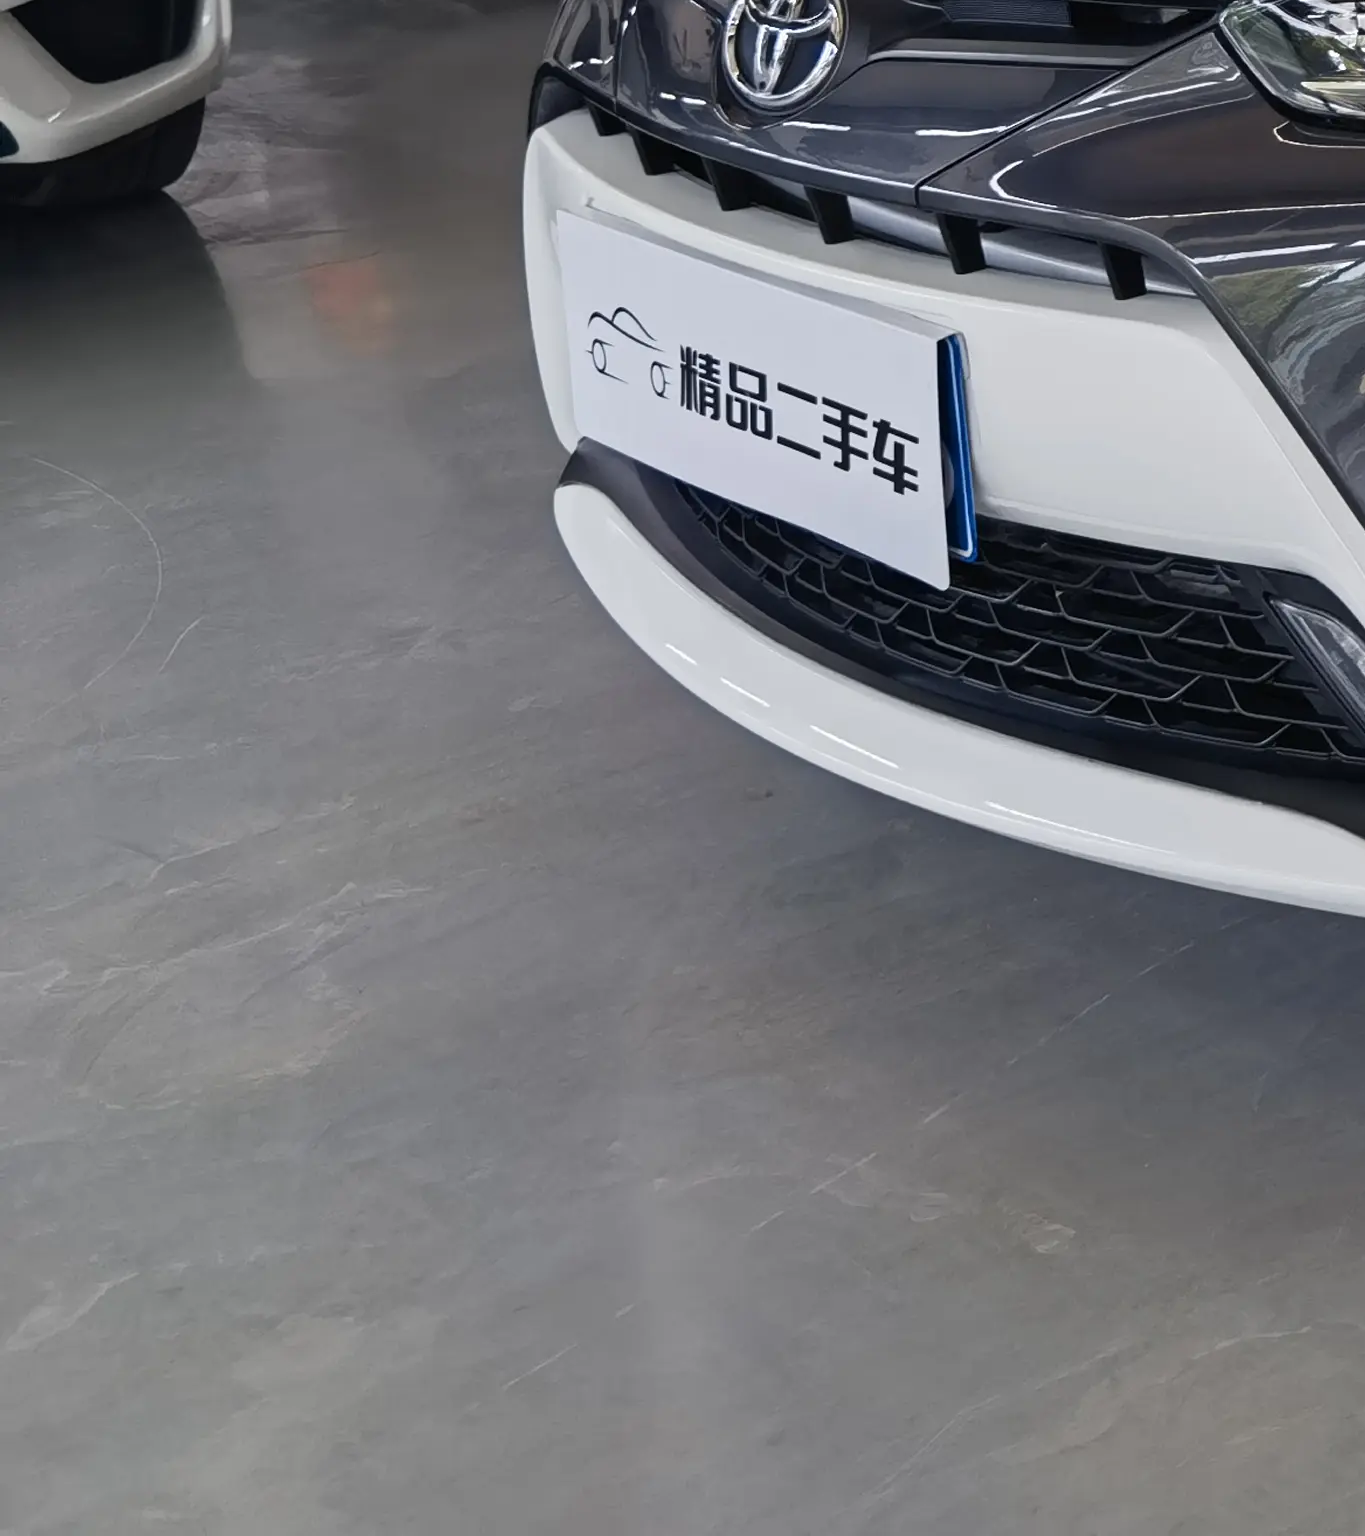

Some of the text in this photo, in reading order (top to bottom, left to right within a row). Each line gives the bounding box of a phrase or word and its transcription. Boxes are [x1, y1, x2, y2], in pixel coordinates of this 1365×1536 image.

[679, 344, 920, 495] 精品二手车
